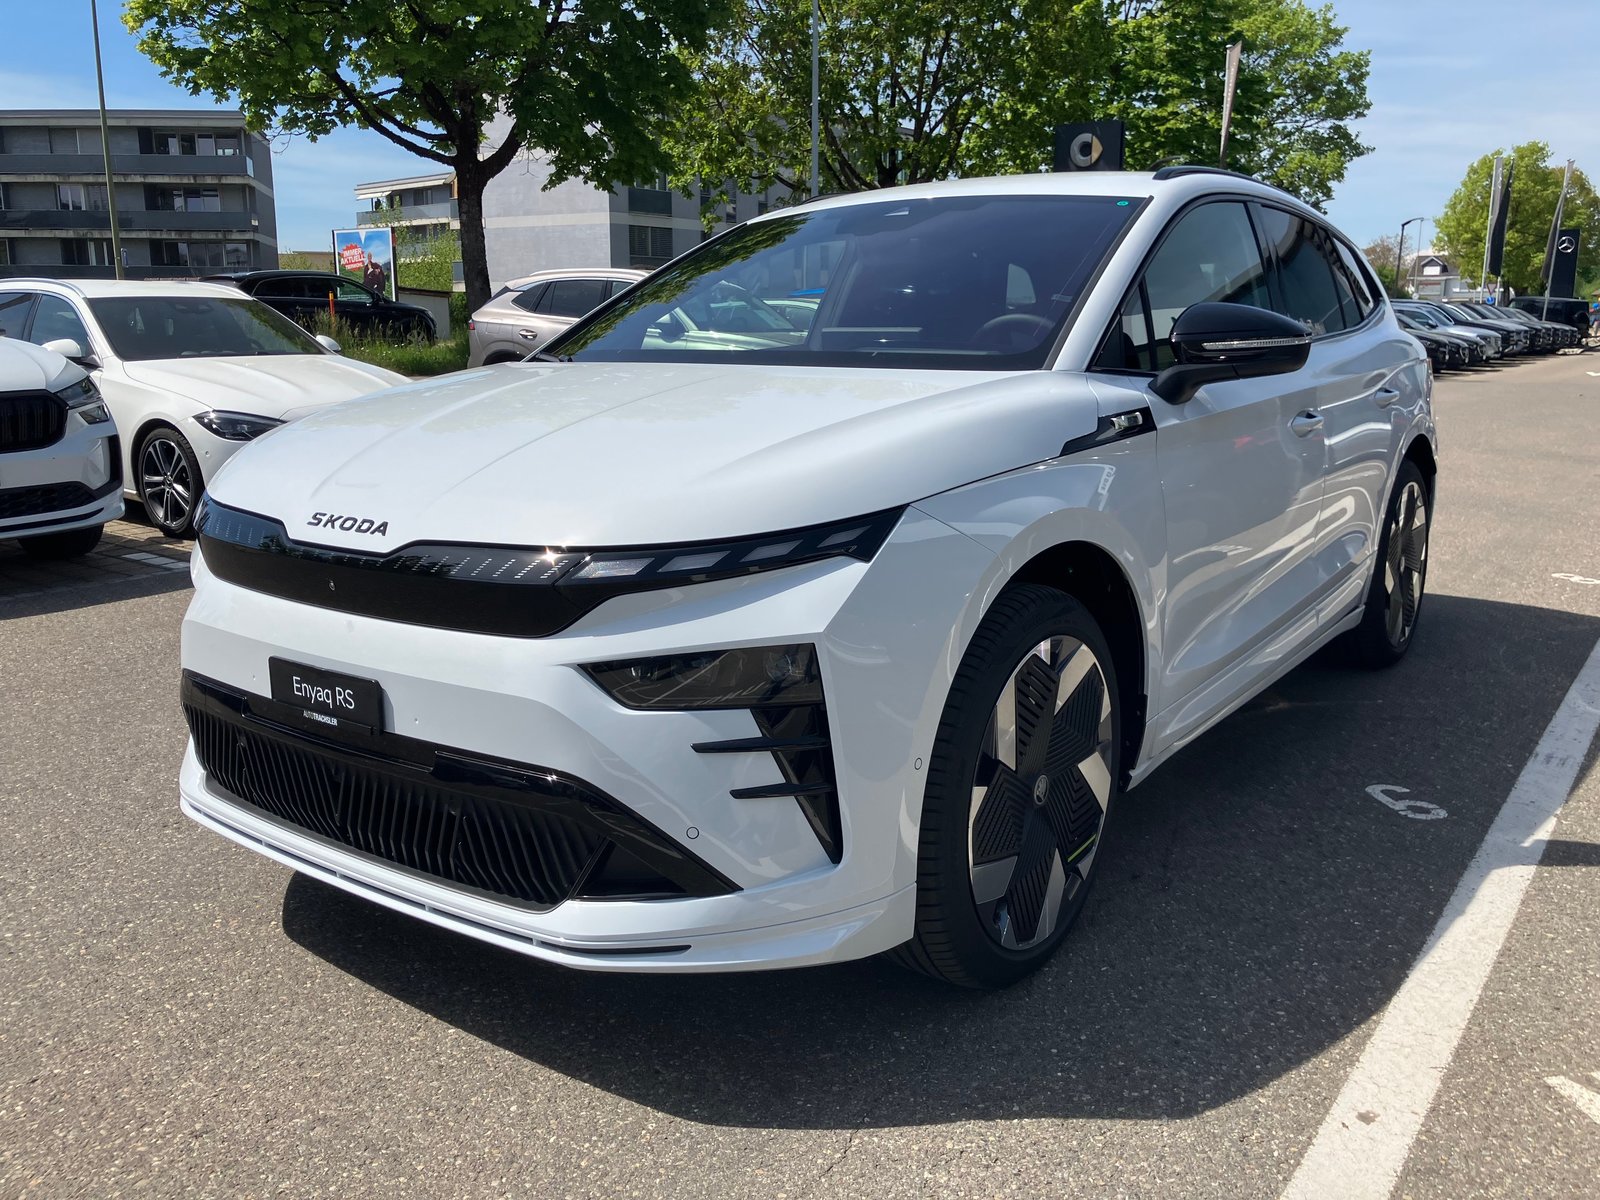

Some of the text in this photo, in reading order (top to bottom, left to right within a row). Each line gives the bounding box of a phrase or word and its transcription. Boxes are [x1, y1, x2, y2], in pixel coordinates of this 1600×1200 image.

[340, 254, 364, 265] AKTUELL
[343, 248, 362, 257] IMMER
[292, 676, 355, 709] Enyaq RS
[1365, 784, 1448, 820] 6
